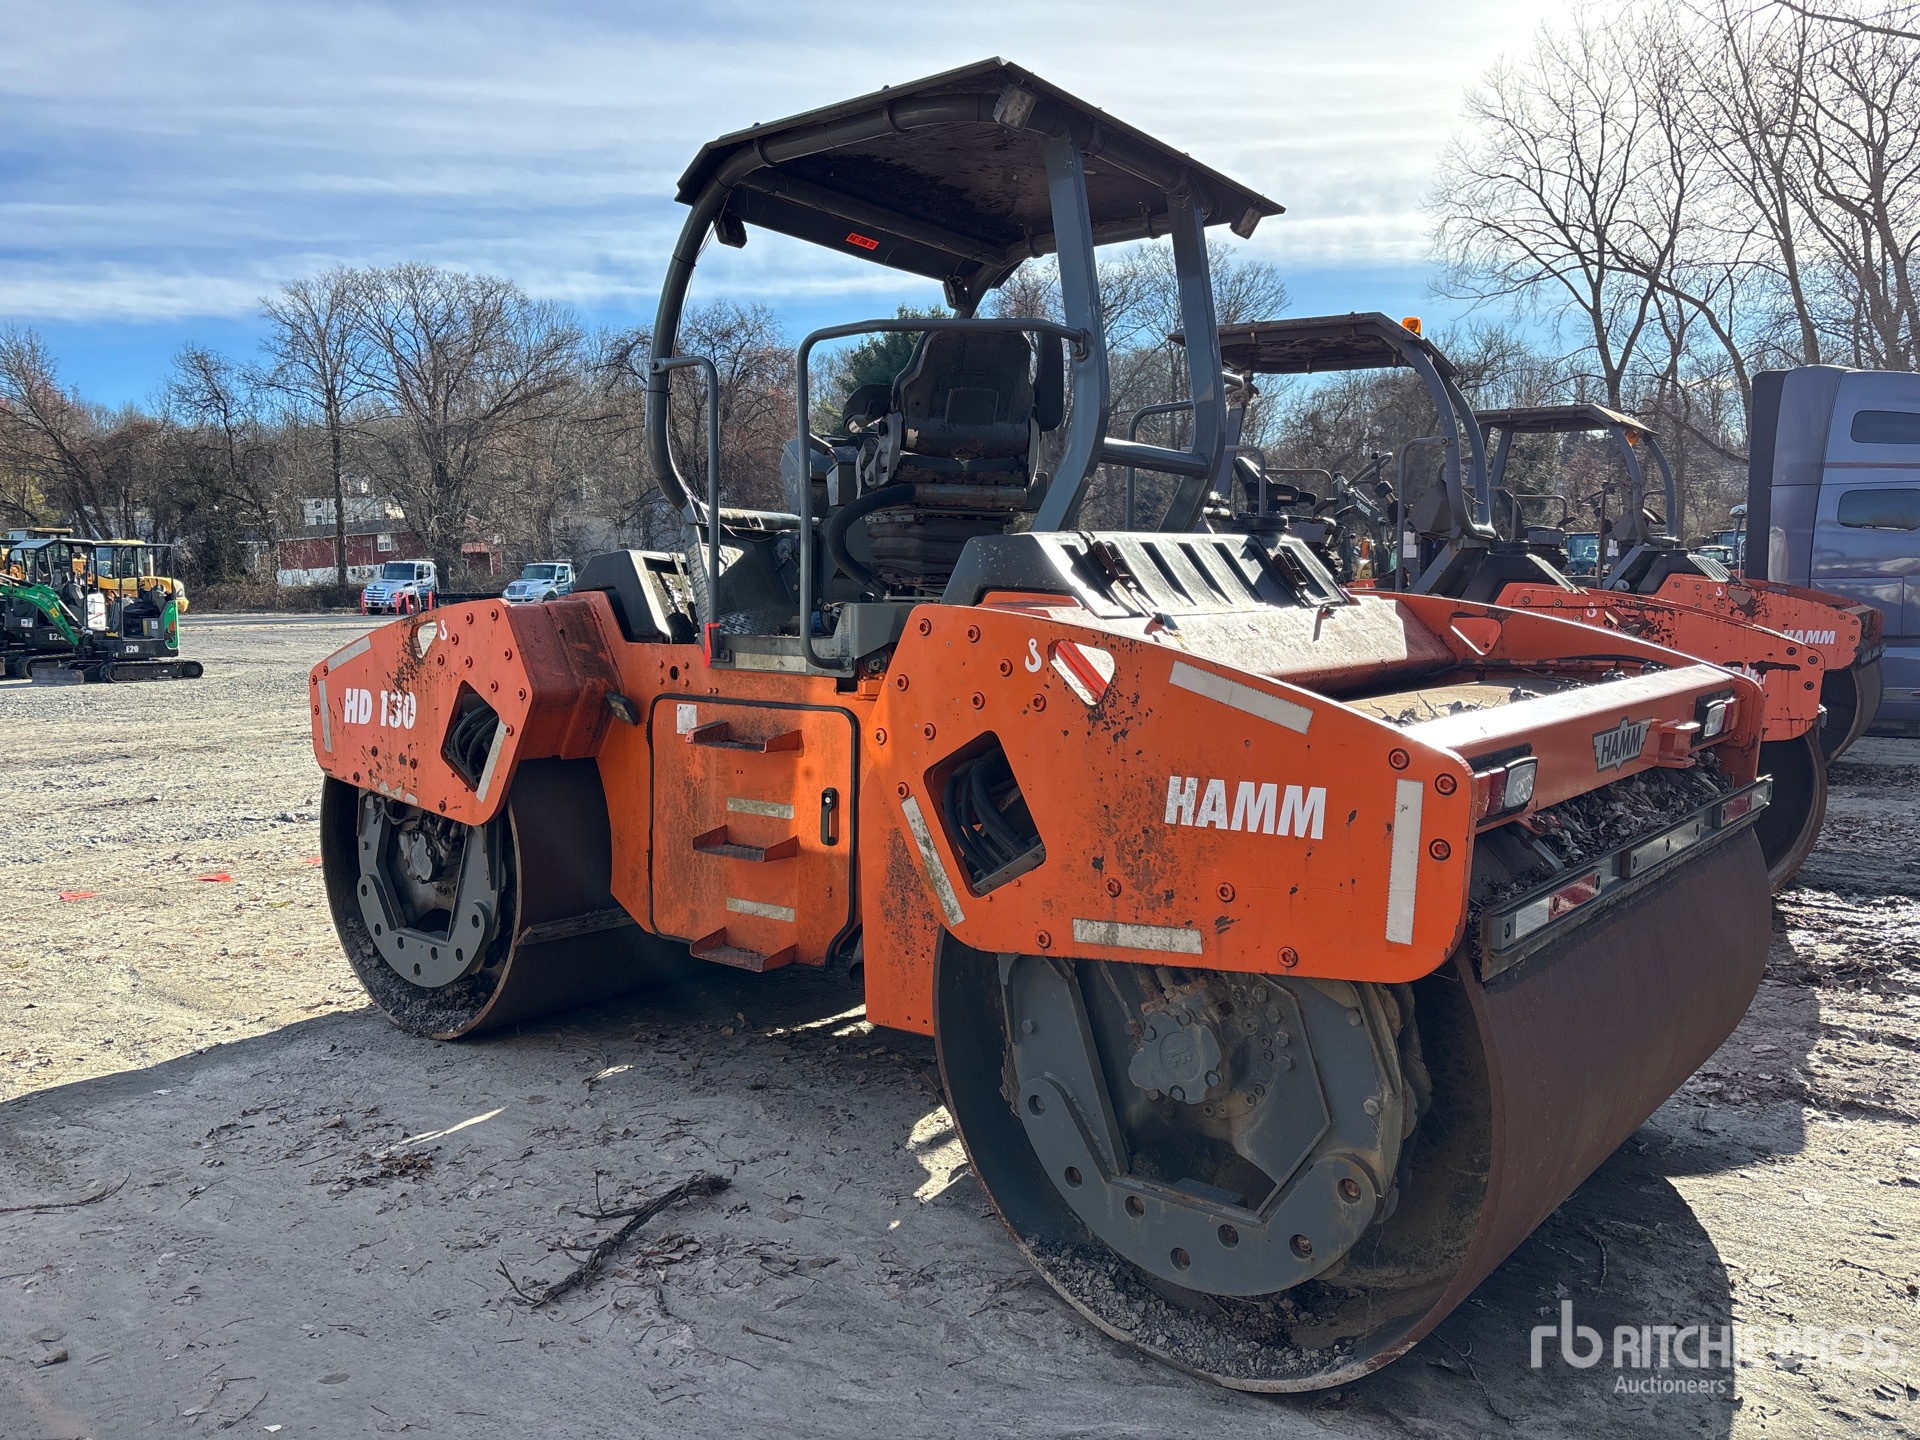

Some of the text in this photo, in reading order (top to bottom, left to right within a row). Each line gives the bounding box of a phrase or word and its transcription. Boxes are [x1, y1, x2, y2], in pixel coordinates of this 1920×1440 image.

[125, 645, 139, 653] E20
[344, 688, 417, 730] HD 130
[1601, 725, 1642, 765] HAMM
[1164, 775, 1327, 840] HAMM
